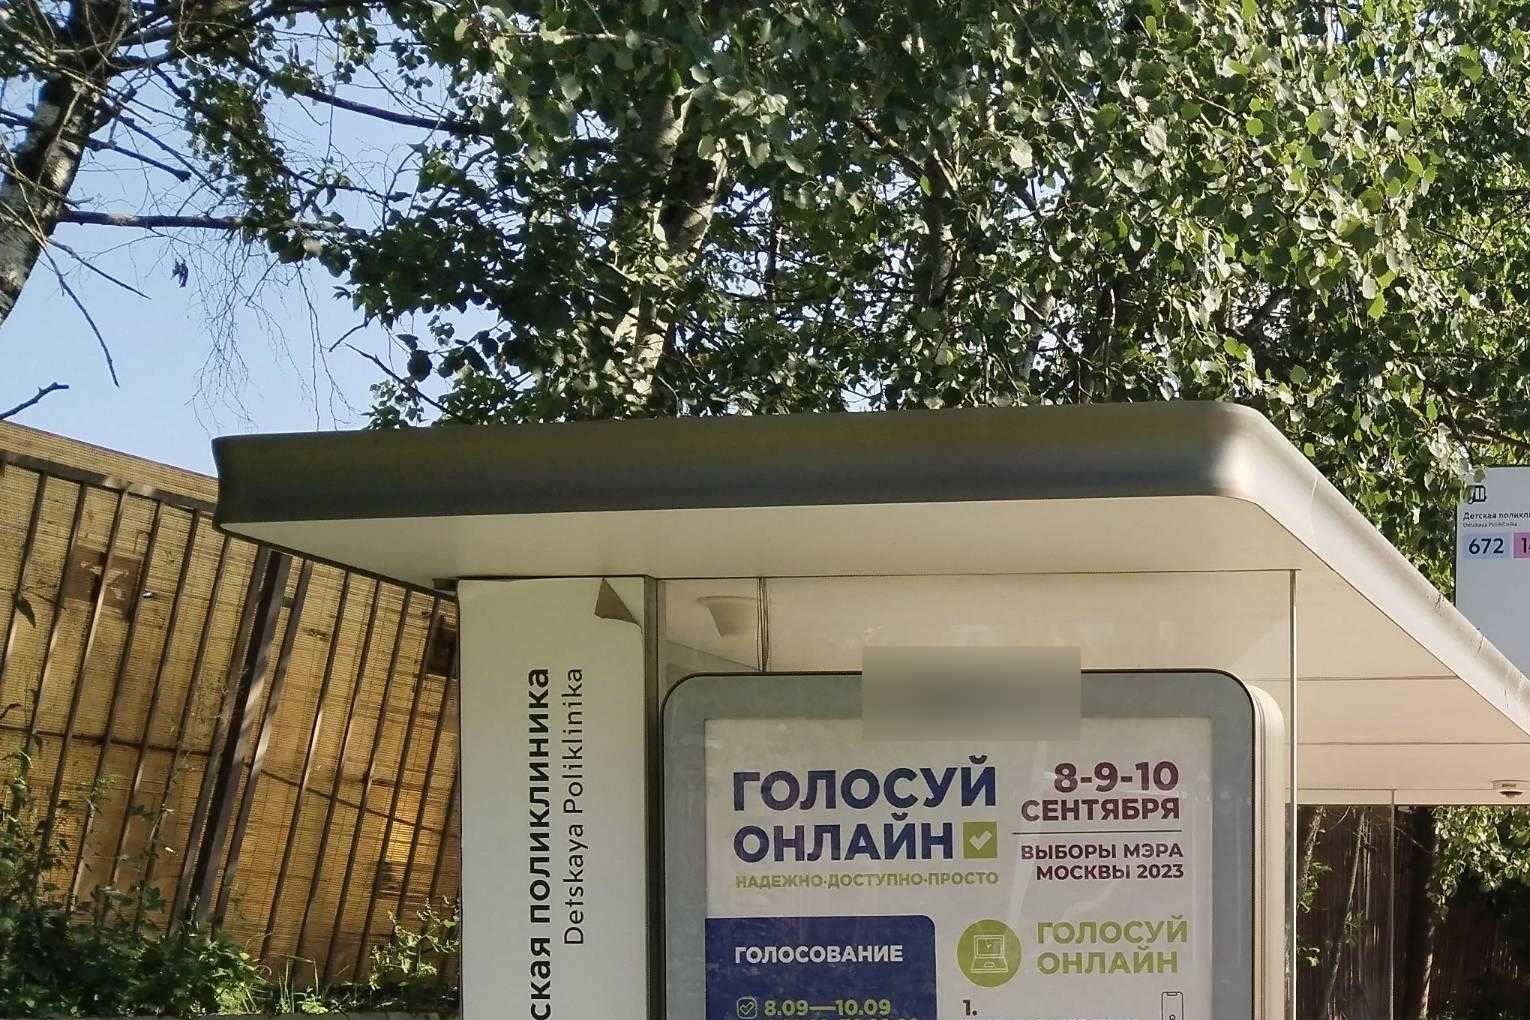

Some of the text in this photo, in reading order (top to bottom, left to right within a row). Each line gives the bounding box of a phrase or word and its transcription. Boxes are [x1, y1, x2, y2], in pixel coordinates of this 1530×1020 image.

[1468, 537, 1504, 554] 672
[733, 754, 997, 812] ГОЛОСУЙ
[1053, 761, 1180, 793] 8-9-10
[528, 667, 550, 924] поликлиника
[562, 668, 589, 945] Detskaya Poliklinika
[1021, 798, 1181, 822] СЕНТЯБРЯ
[733, 812, 954, 863] ОНЛАЙН
[1020, 842, 1184, 861] ВЫБОРЫ МЭРА
[1036, 862, 1185, 881] МОСКВЫ 2023
[1037, 915, 1189, 944] ГОЛОСУЙ
[735, 945, 904, 964] ГОЛОСОВАНИЕ
[1037, 945, 1179, 975] ОНЛАЙН
[962, 999, 978, 1016] 1.
